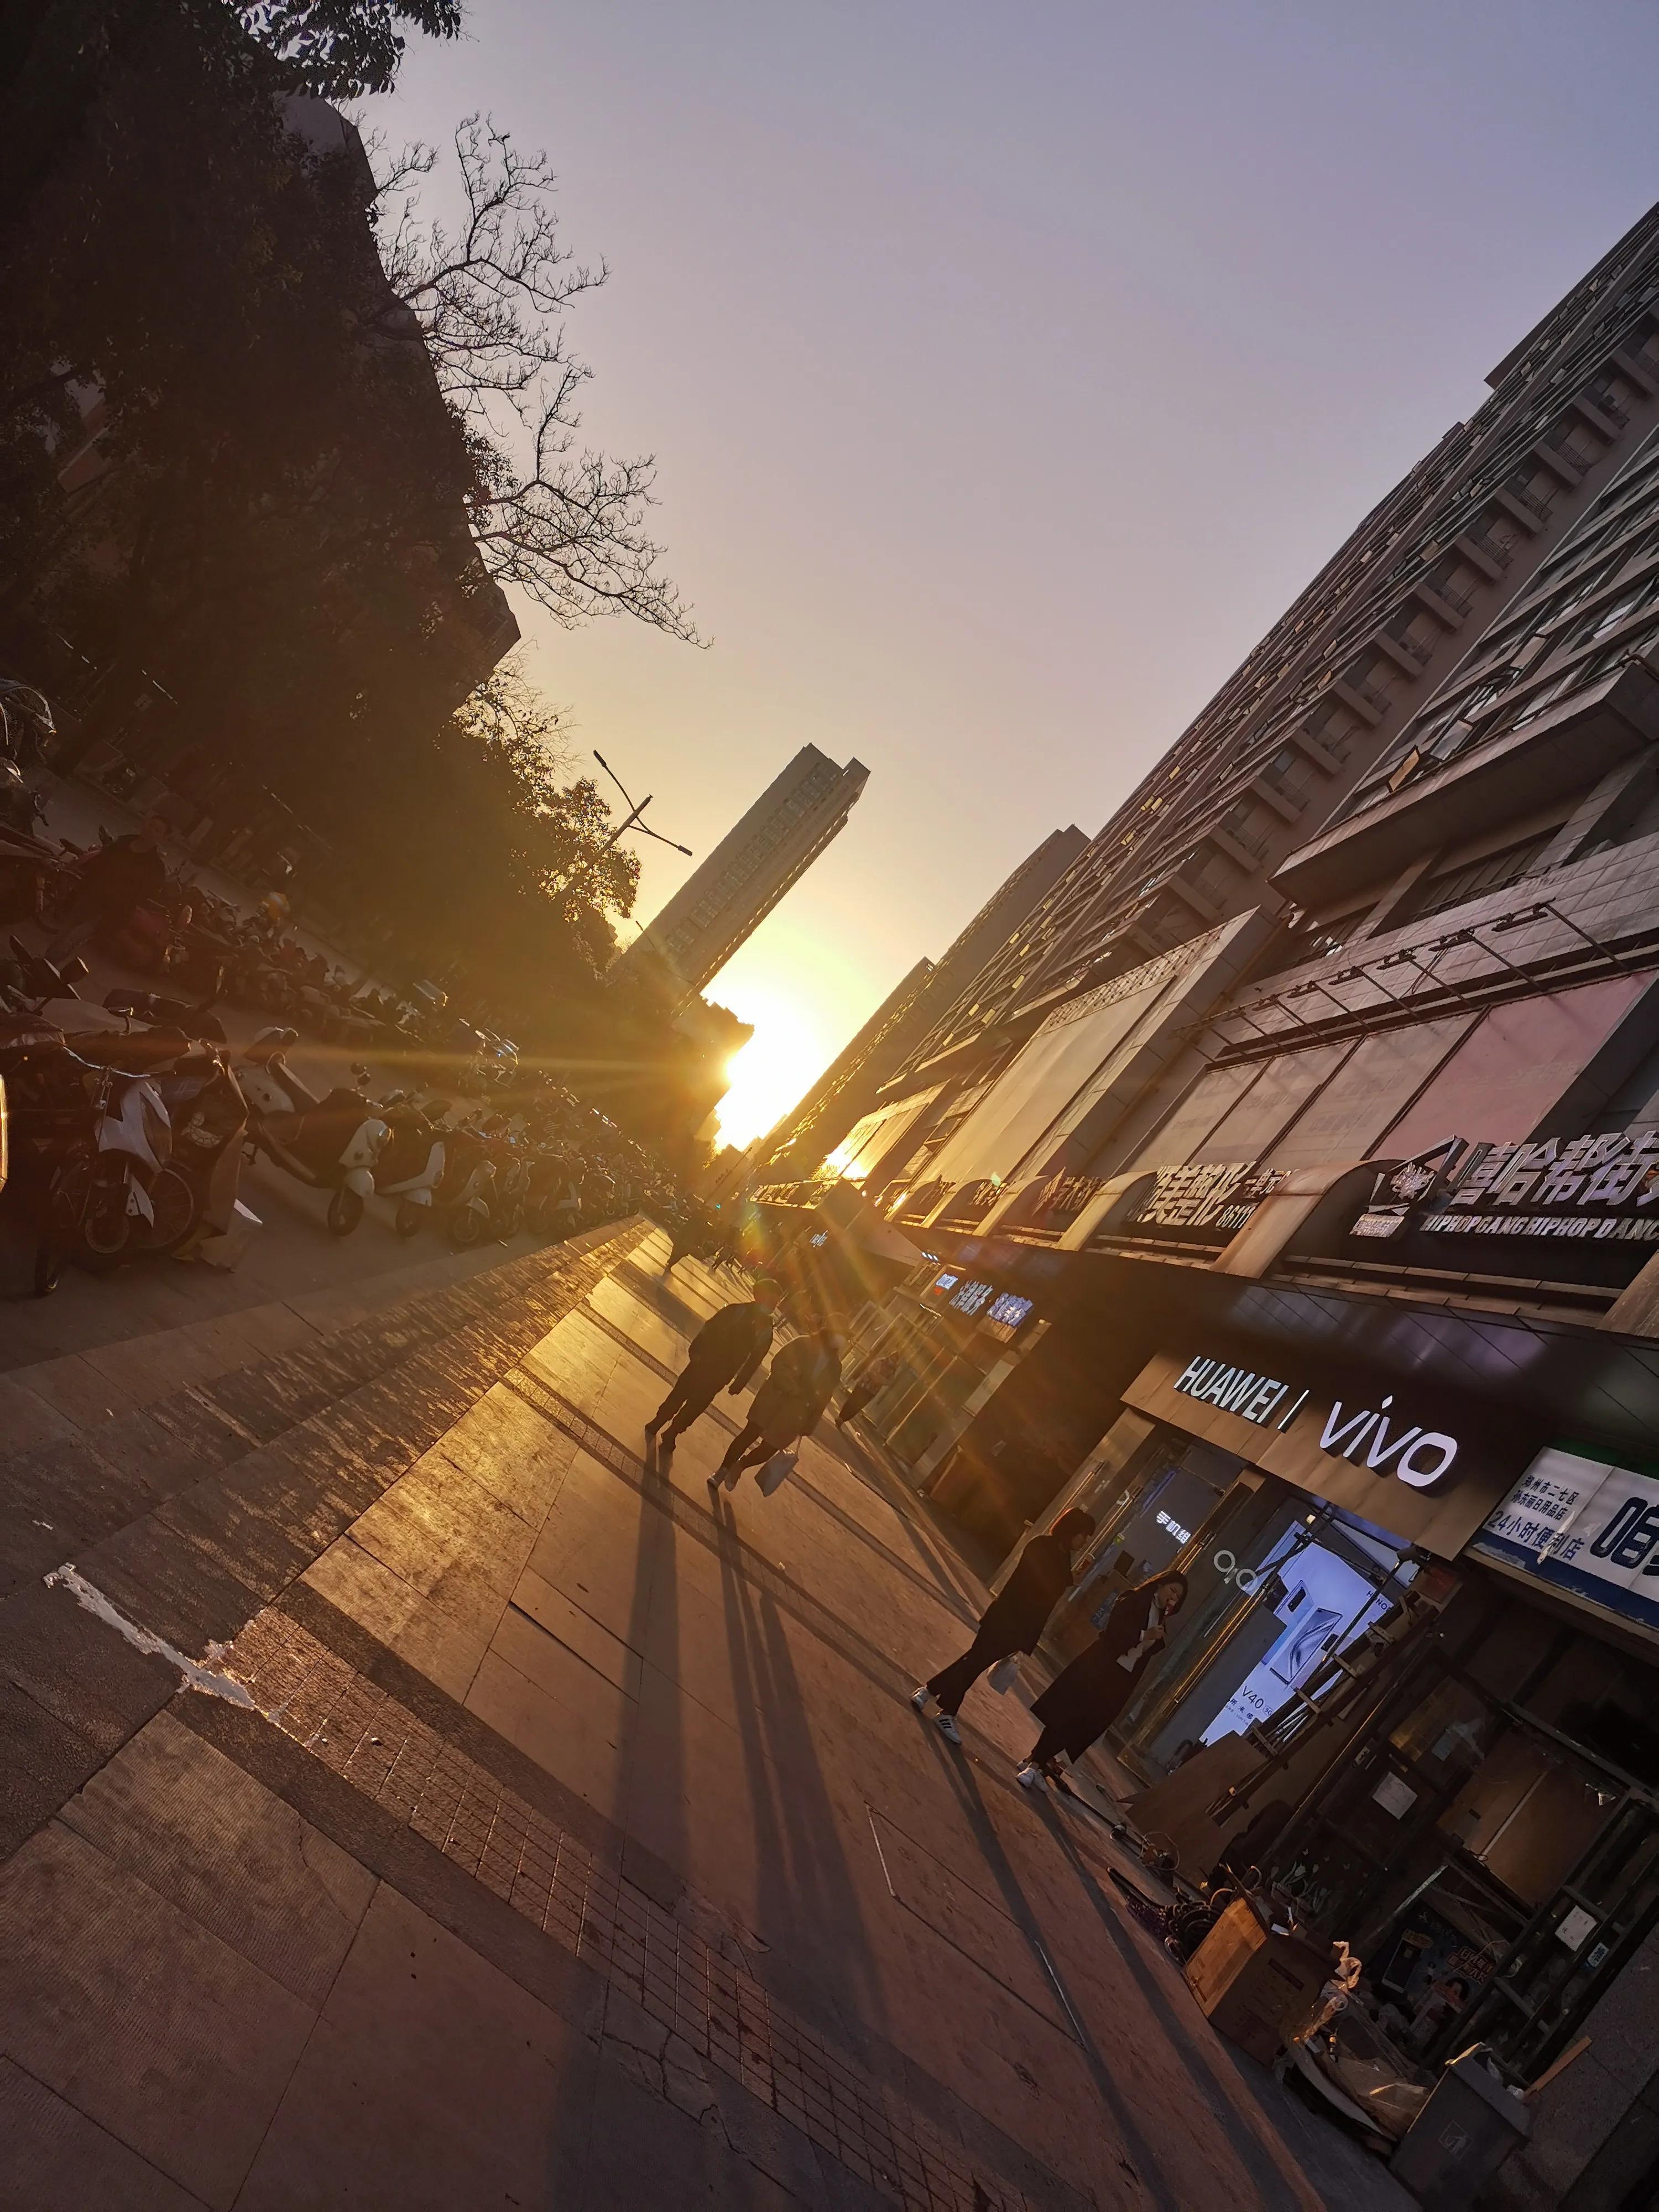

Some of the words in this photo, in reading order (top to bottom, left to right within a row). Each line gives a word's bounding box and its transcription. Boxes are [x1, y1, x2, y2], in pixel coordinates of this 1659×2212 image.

[1245, 1168, 1292, 1195] 一单元
[1446, 1130, 1659, 1207] 嘻哈帮街
[1048, 1176, 1106, 1211] 学大教
[1592, 1218, 1659, 1243] DANC
[1173, 1355, 1290, 1423] HUAWEI
[1319, 1395, 1458, 1487] vivo
[1522, 1475, 1580, 1505] 郑州市二七区
[1487, 1510, 1585, 1561] 24小时便利店
[1366, 1590, 1391, 1611] HNO
[1242, 1686, 1265, 1709] V40
